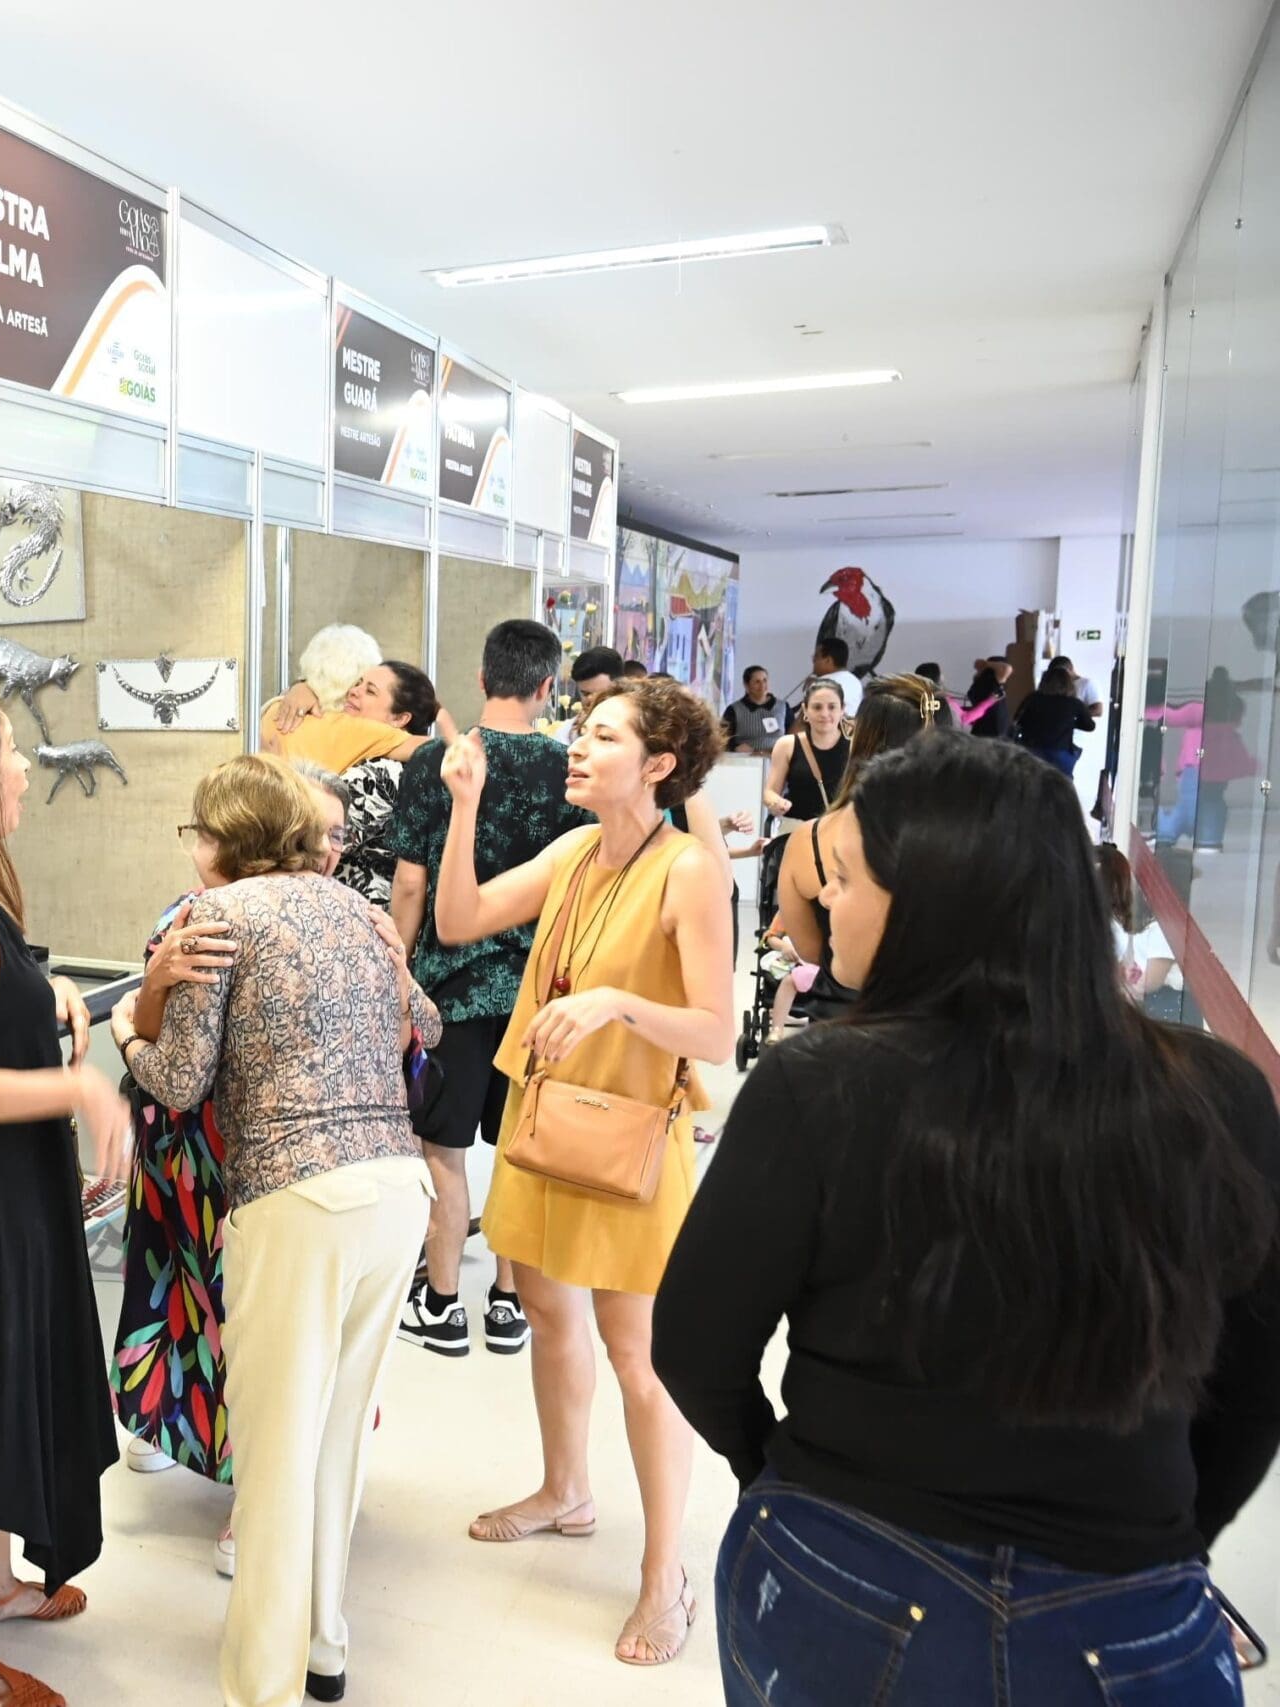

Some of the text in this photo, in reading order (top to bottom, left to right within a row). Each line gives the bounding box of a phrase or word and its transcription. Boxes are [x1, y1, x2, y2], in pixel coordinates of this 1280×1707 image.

[6, 308, 49, 338] ARTESÃ
[343, 346, 381, 382] MESTRE
[344, 381, 378, 414] GUARÁ
